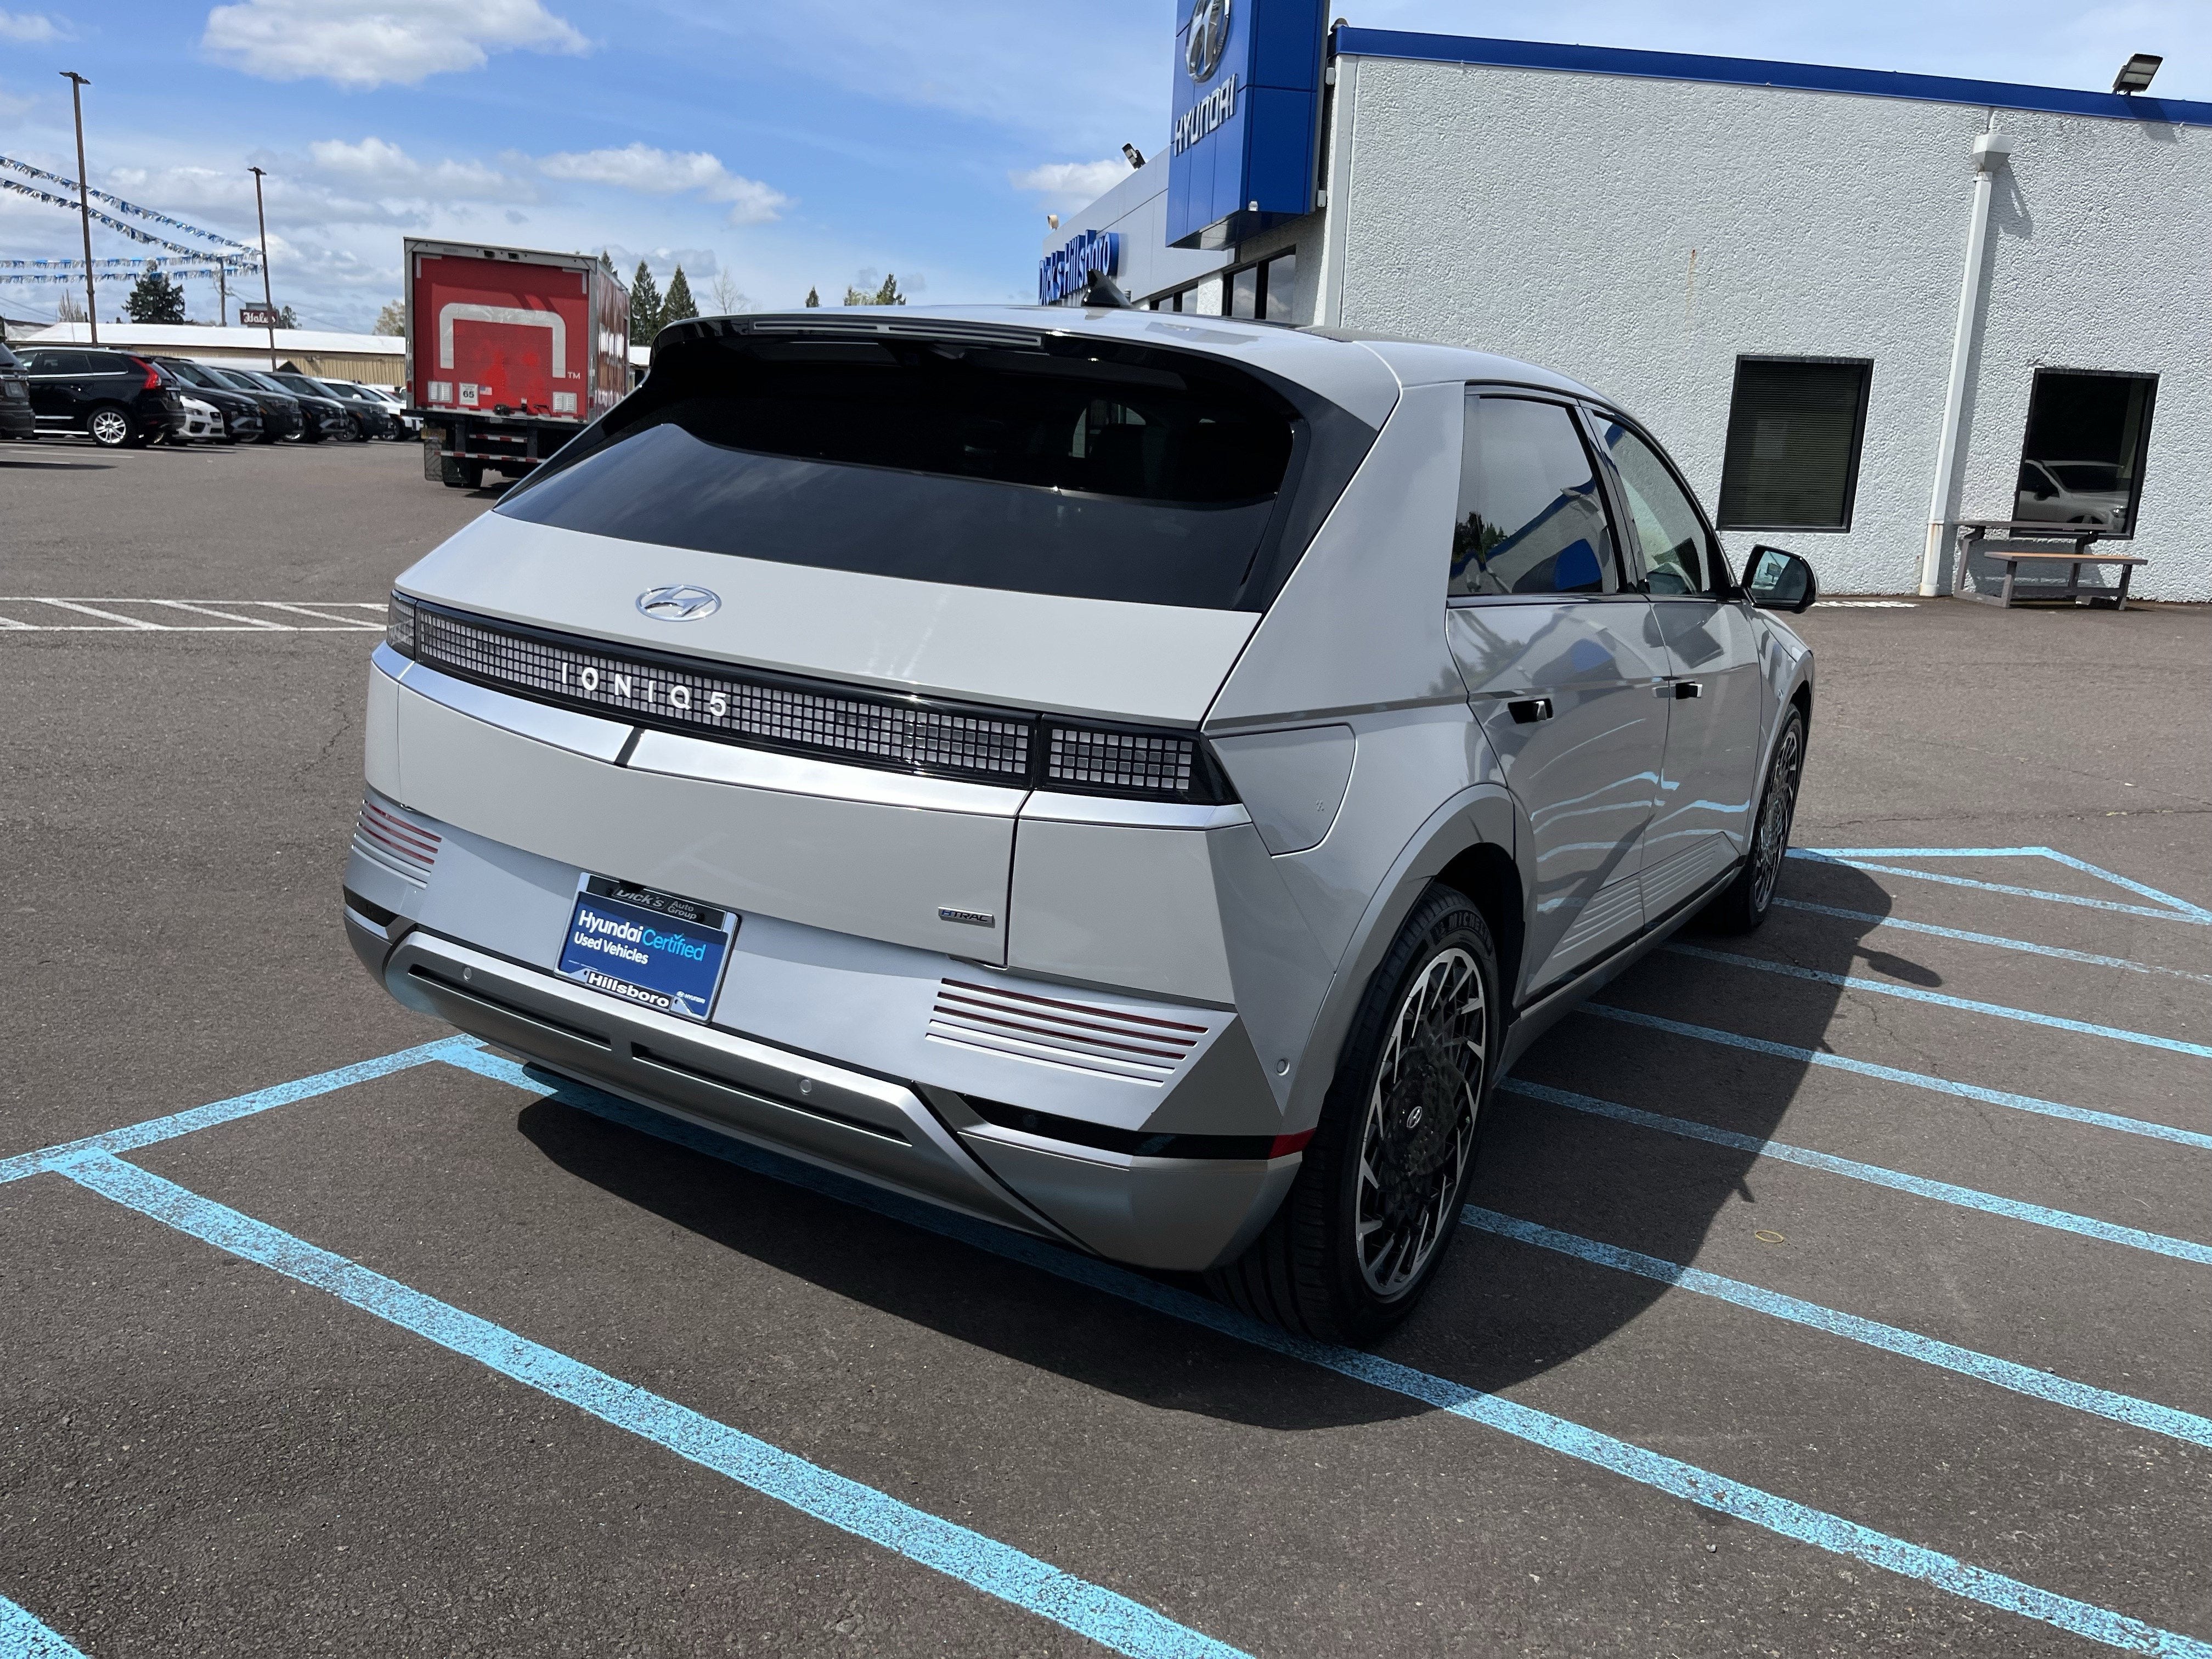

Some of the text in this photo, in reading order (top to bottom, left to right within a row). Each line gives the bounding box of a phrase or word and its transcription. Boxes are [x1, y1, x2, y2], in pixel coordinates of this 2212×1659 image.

[1174, 73, 1237, 157] HYUNDAI
[1063, 229, 1112, 295] Hillsboro
[463, 390, 475, 398] 65
[562, 662, 727, 717] IONIQ 5
[667, 905, 697, 919] Group
[671, 900, 695, 912] Auto
[574, 931, 650, 964] Used Vehicles
[578, 910, 707, 961] Hyundai Certified
[589, 972, 670, 1007] Hillsboro
